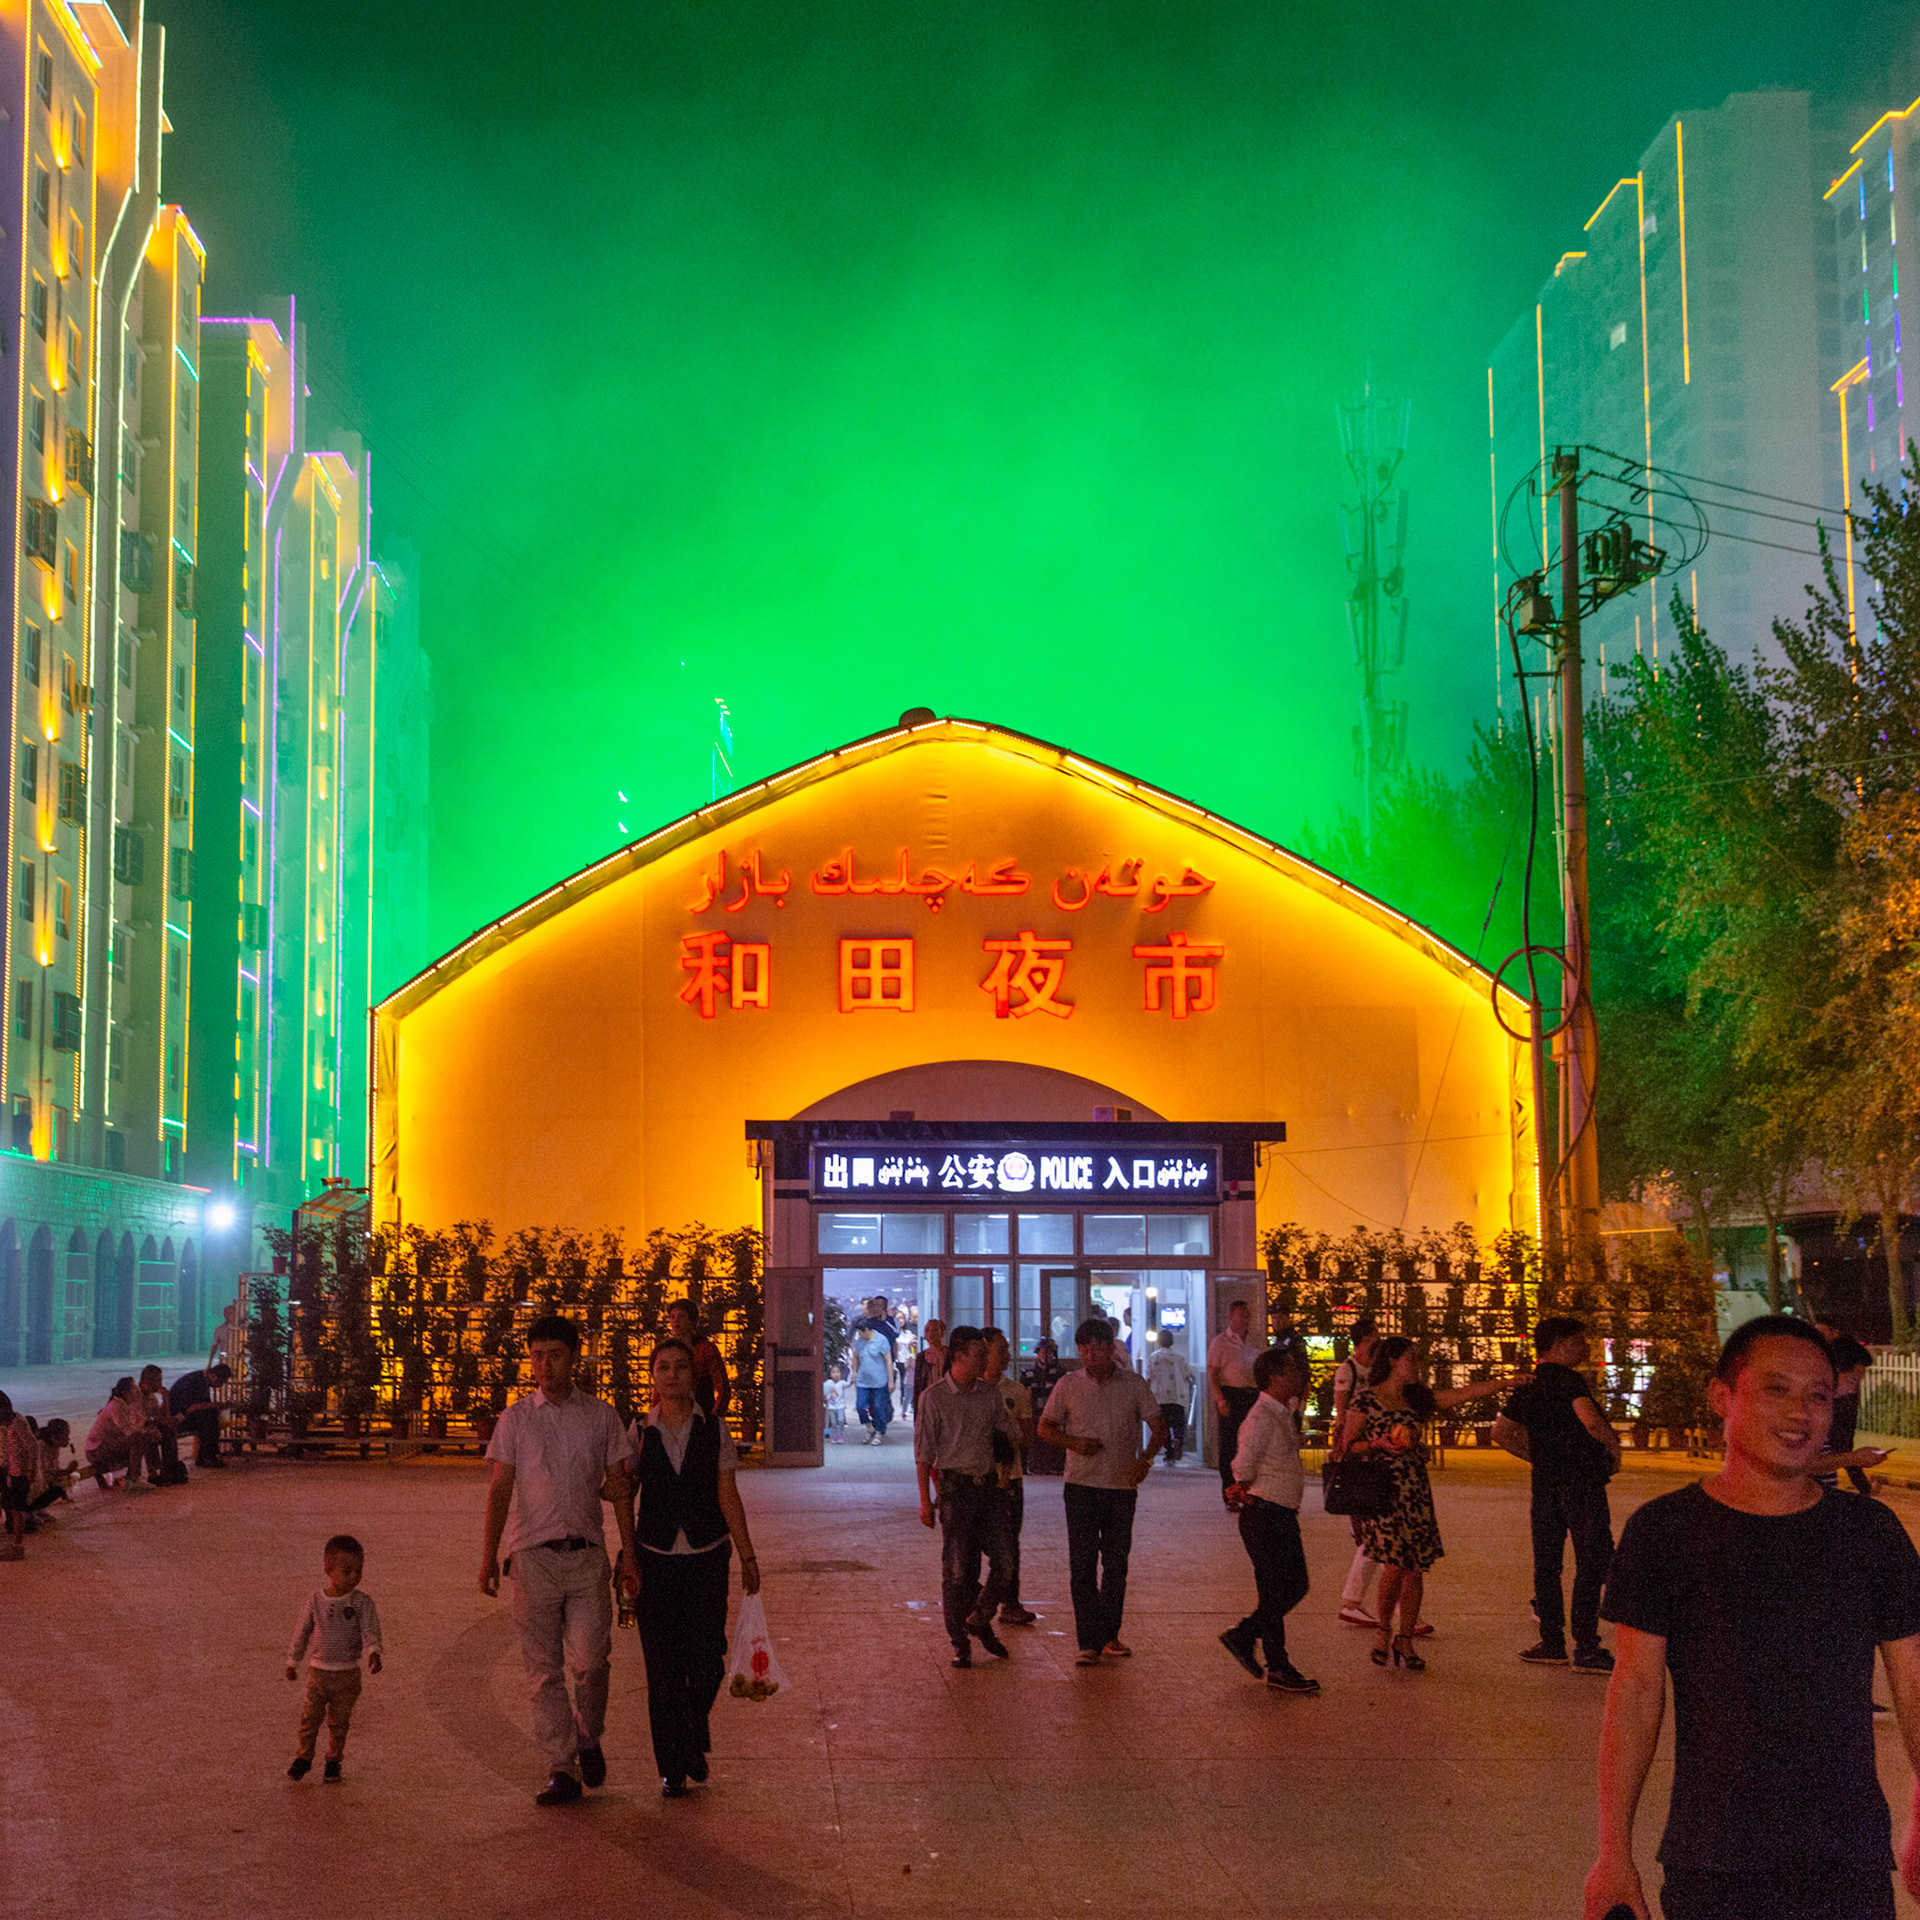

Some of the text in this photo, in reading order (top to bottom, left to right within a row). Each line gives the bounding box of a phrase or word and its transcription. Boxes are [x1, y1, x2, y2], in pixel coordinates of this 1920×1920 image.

[689, 848, 791, 914] بازار
[679, 930, 1225, 1020] 和田夜市
[823, 1153, 875, 1189] 出口
[938, 1154, 996, 1189] 公安
[1040, 1156, 1093, 1190] POLICE
[1101, 1155, 1156, 1190] 入口
